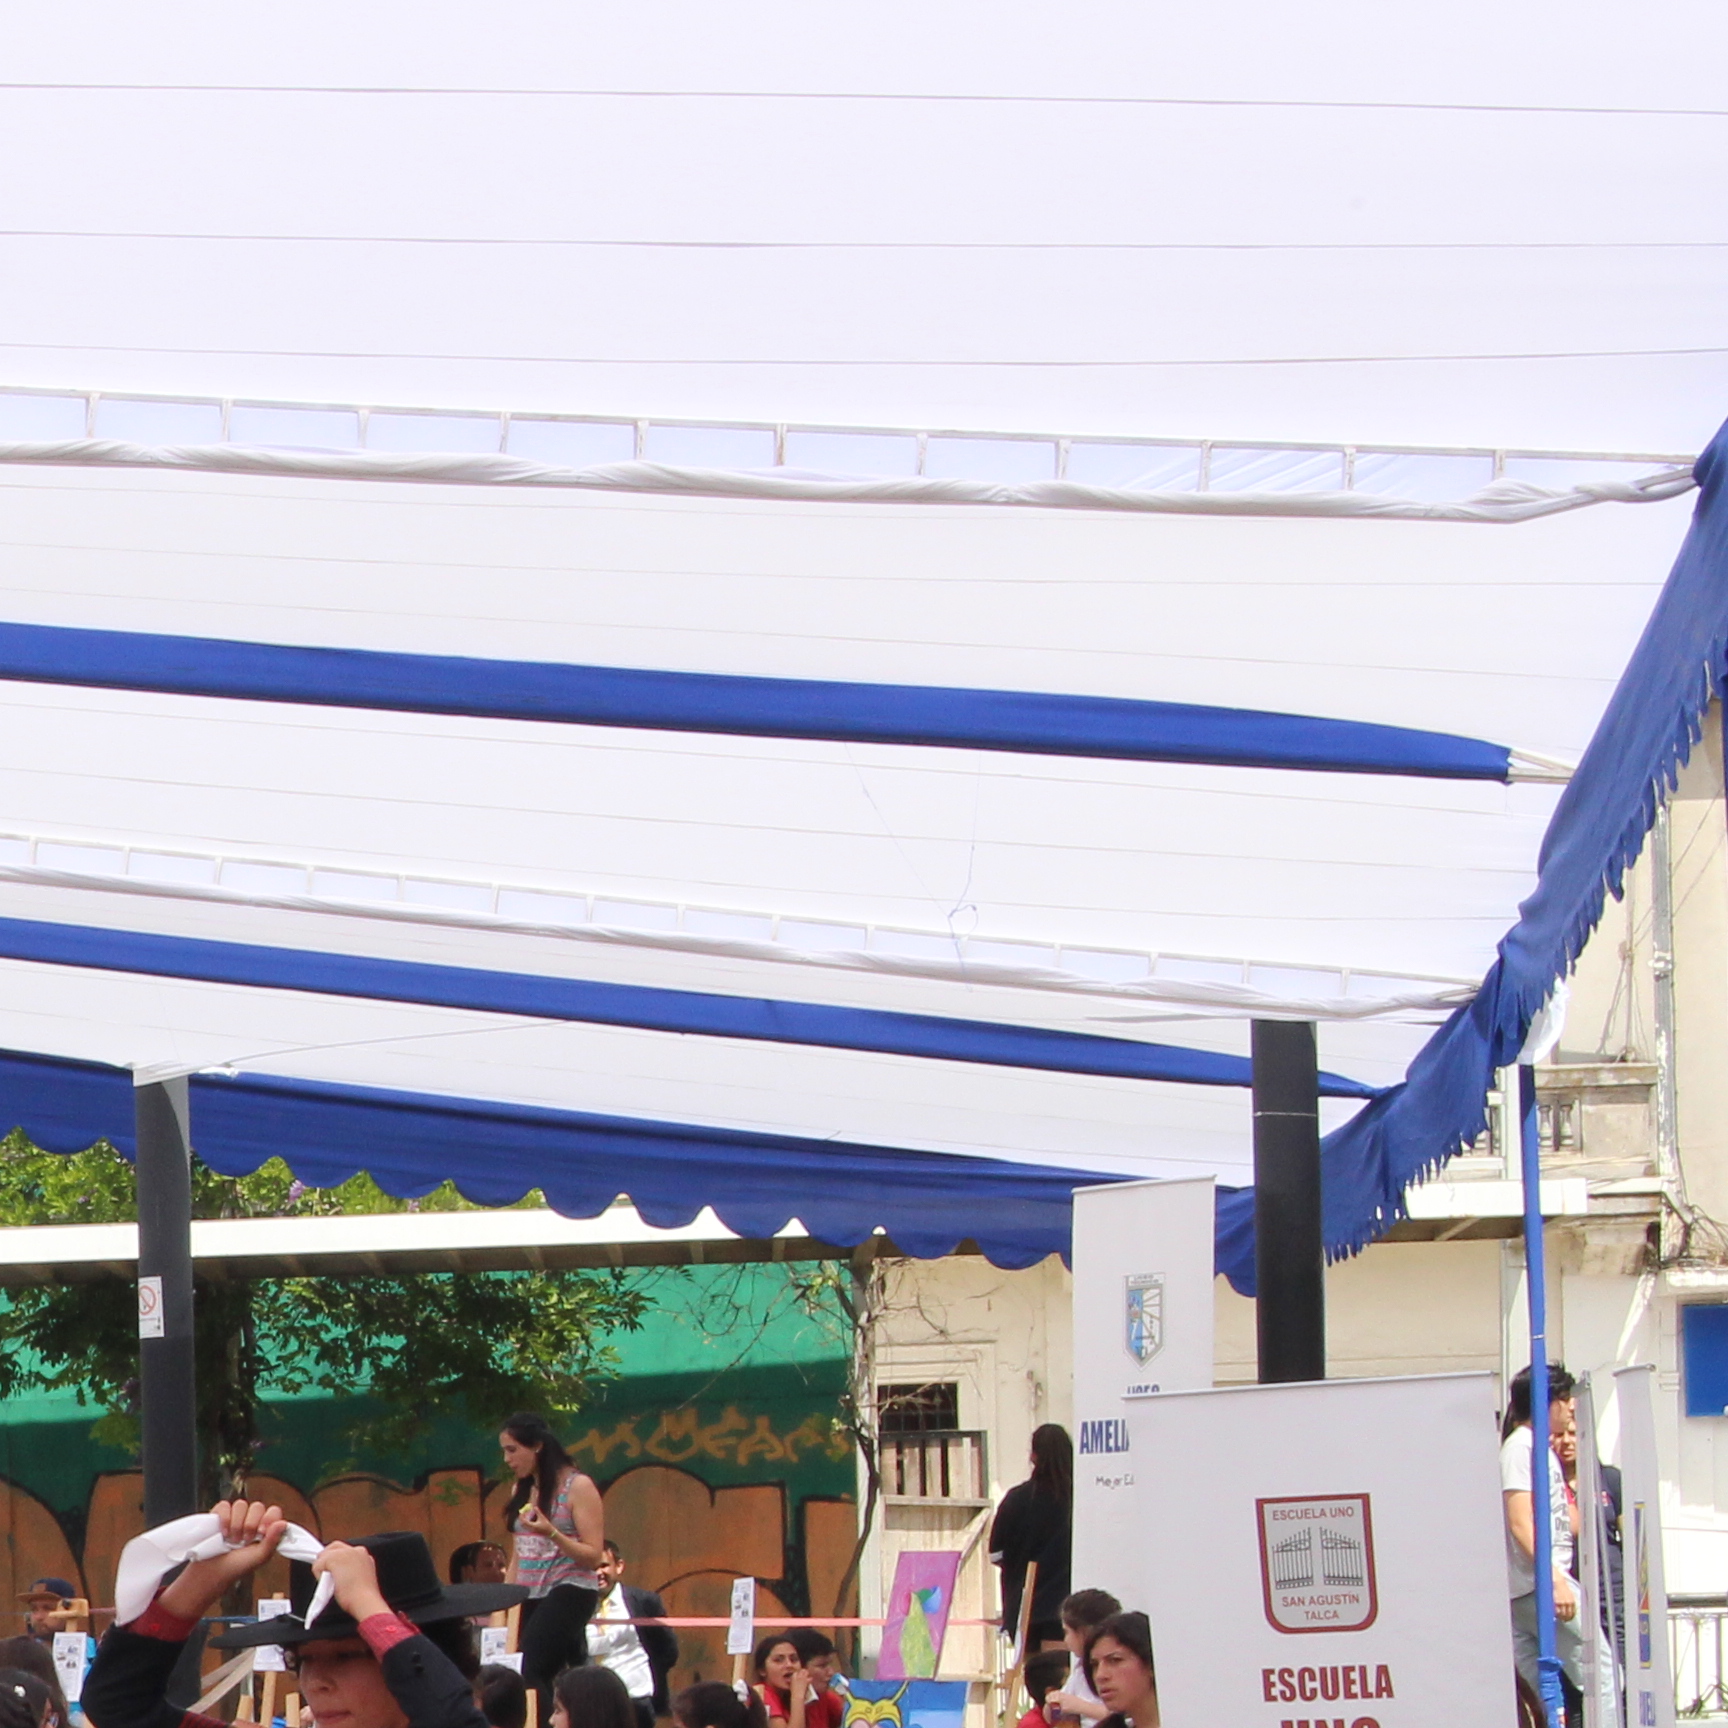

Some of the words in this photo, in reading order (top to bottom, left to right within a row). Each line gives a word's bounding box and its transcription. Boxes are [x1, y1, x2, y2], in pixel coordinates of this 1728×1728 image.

[1272, 1508, 1327, 1521] ESCUELA
[1330, 1506, 1355, 1518] UNO
[1282, 1596, 1306, 1607] SAN
[1308, 1591, 1359, 1606] AGUSTÍN
[1304, 1610, 1340, 1620] TALCA
[1261, 1664, 1395, 1703] ESCUELA
